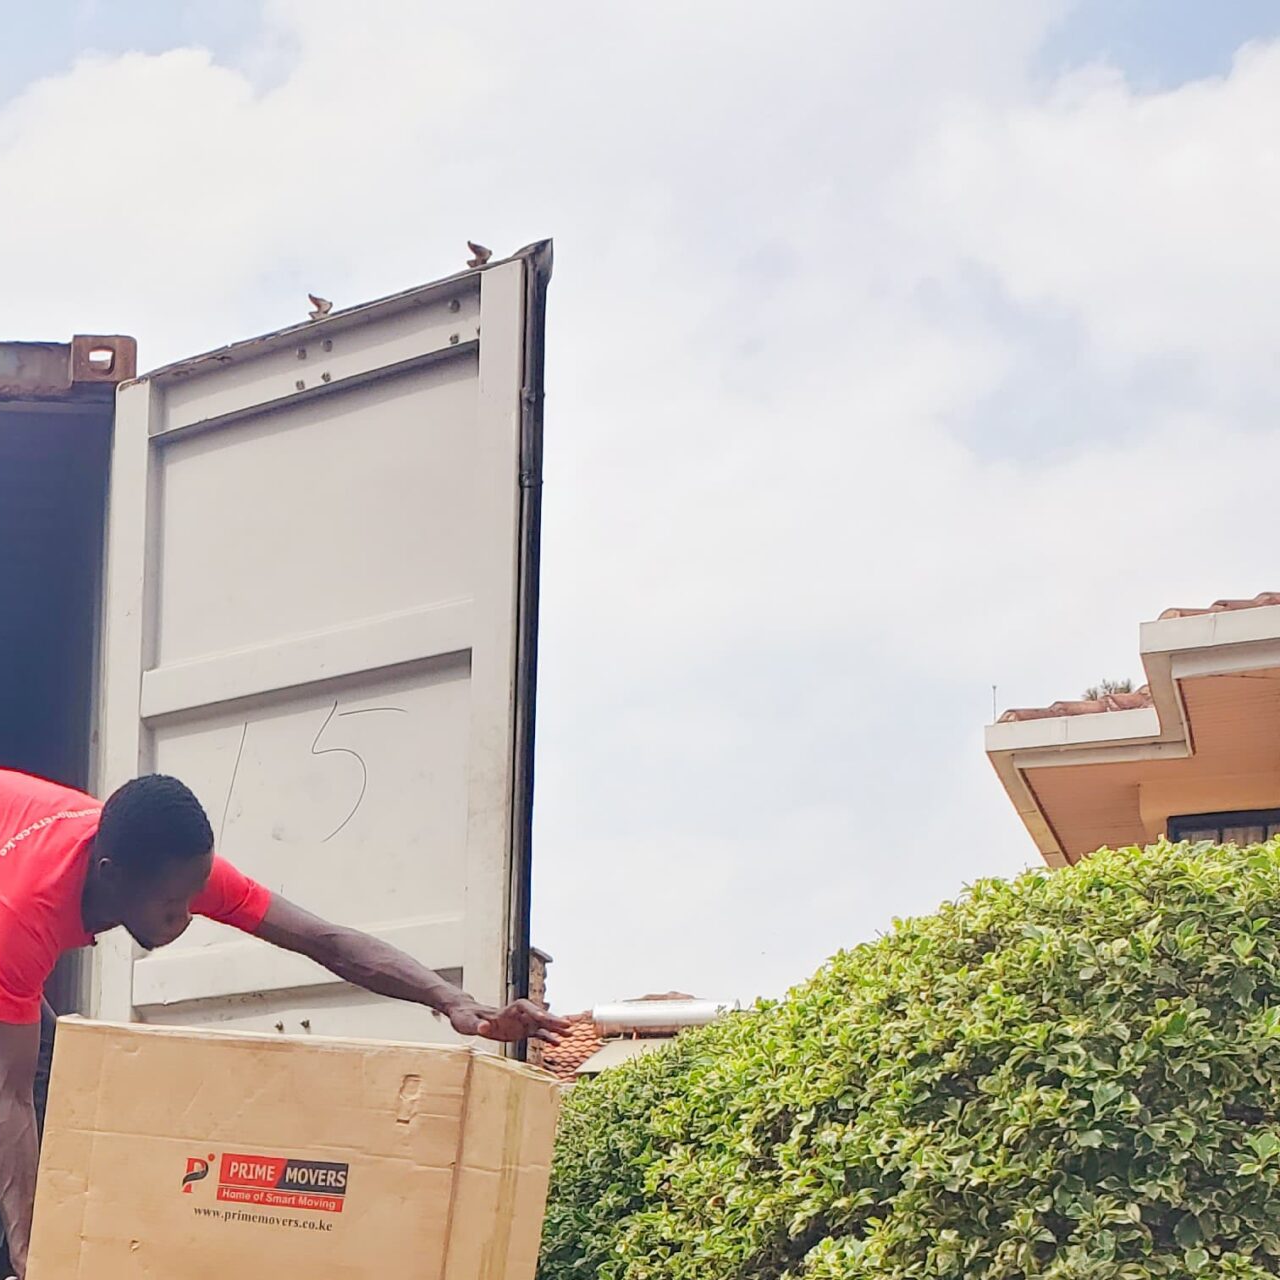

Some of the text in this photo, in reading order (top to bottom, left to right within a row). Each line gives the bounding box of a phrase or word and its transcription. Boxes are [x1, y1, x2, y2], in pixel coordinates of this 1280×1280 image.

[229, 1161, 276, 1182] PRIME
[285, 1166, 347, 1188] MOVERS
[222, 1188, 337, 1211] Home of Smart Moving
[193, 1205, 333, 1232] www.primemovers.co.ke
